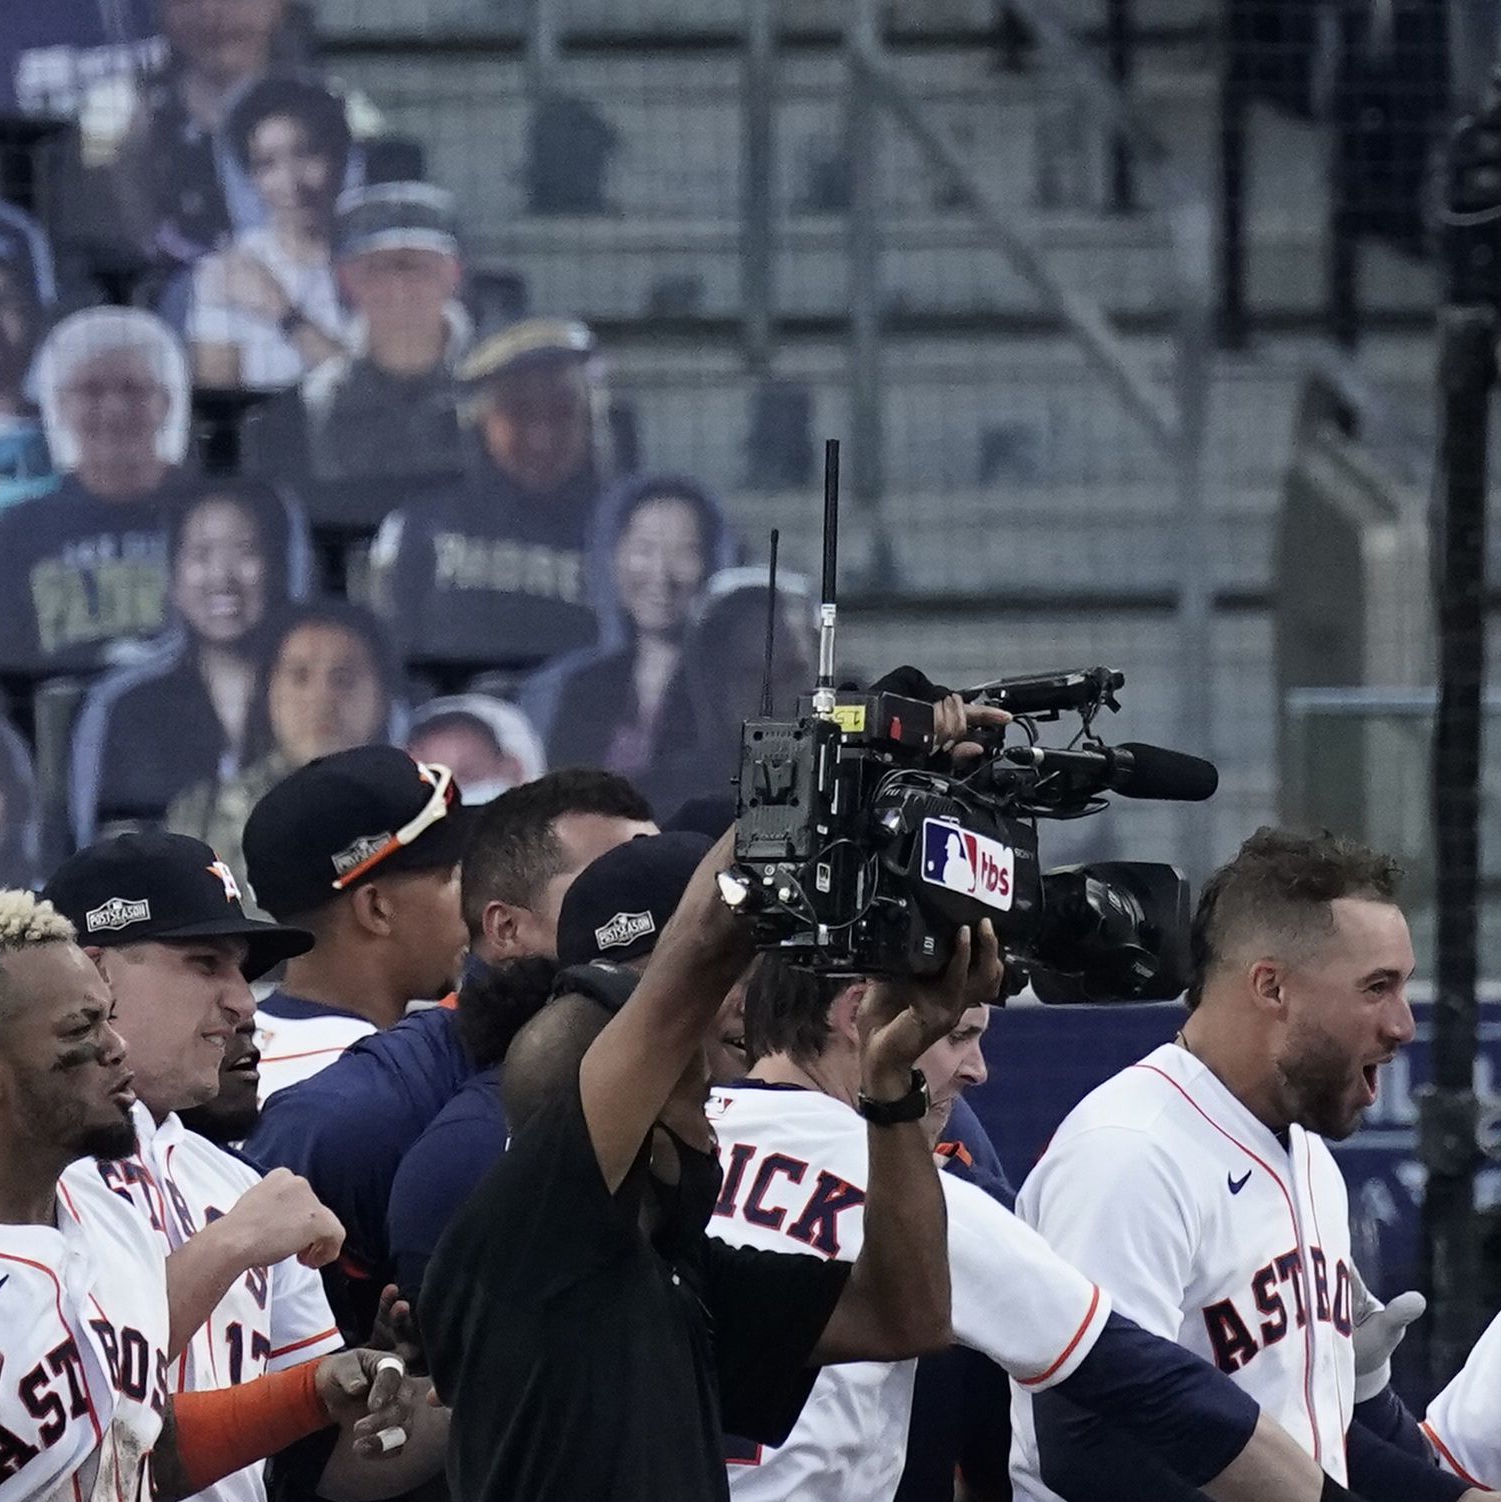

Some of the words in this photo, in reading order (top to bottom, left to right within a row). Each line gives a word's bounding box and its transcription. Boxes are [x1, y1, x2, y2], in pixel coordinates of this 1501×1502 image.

[981, 850, 1010, 897] tbs
[90, 902, 147, 929] POSTSEASON
[597, 914, 653, 946] POSTSEASON
